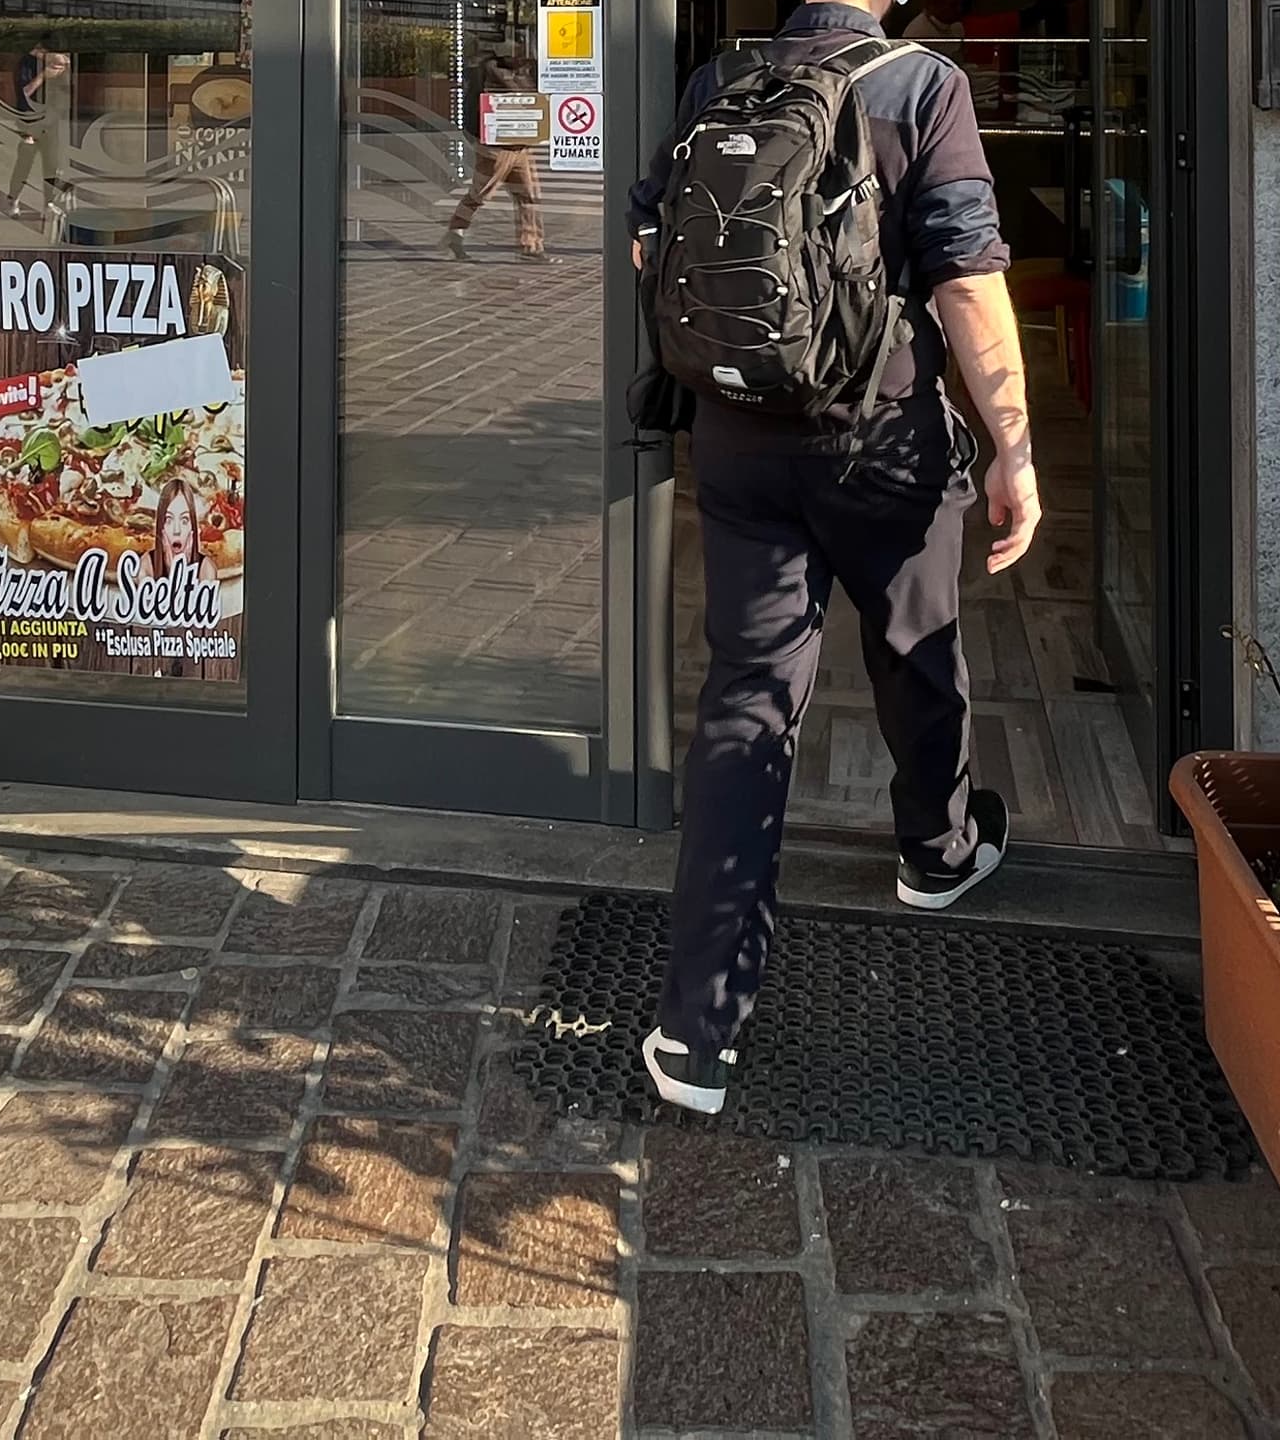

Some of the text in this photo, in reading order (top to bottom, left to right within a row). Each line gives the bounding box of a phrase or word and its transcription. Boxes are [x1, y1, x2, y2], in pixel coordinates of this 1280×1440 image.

[553, 135, 600, 147] VIETATO
[553, 148, 600, 158] FUMARE
[67, 261, 187, 335] PIZZA
[70, 547, 108, 623] A
[115, 547, 223, 629] Scelta
[10, 620, 88, 638] AGGIUNTA
[33, 642, 49, 658] IN
[153, 630, 184, 659] Pizza
[185, 631, 236, 665] Speciale
